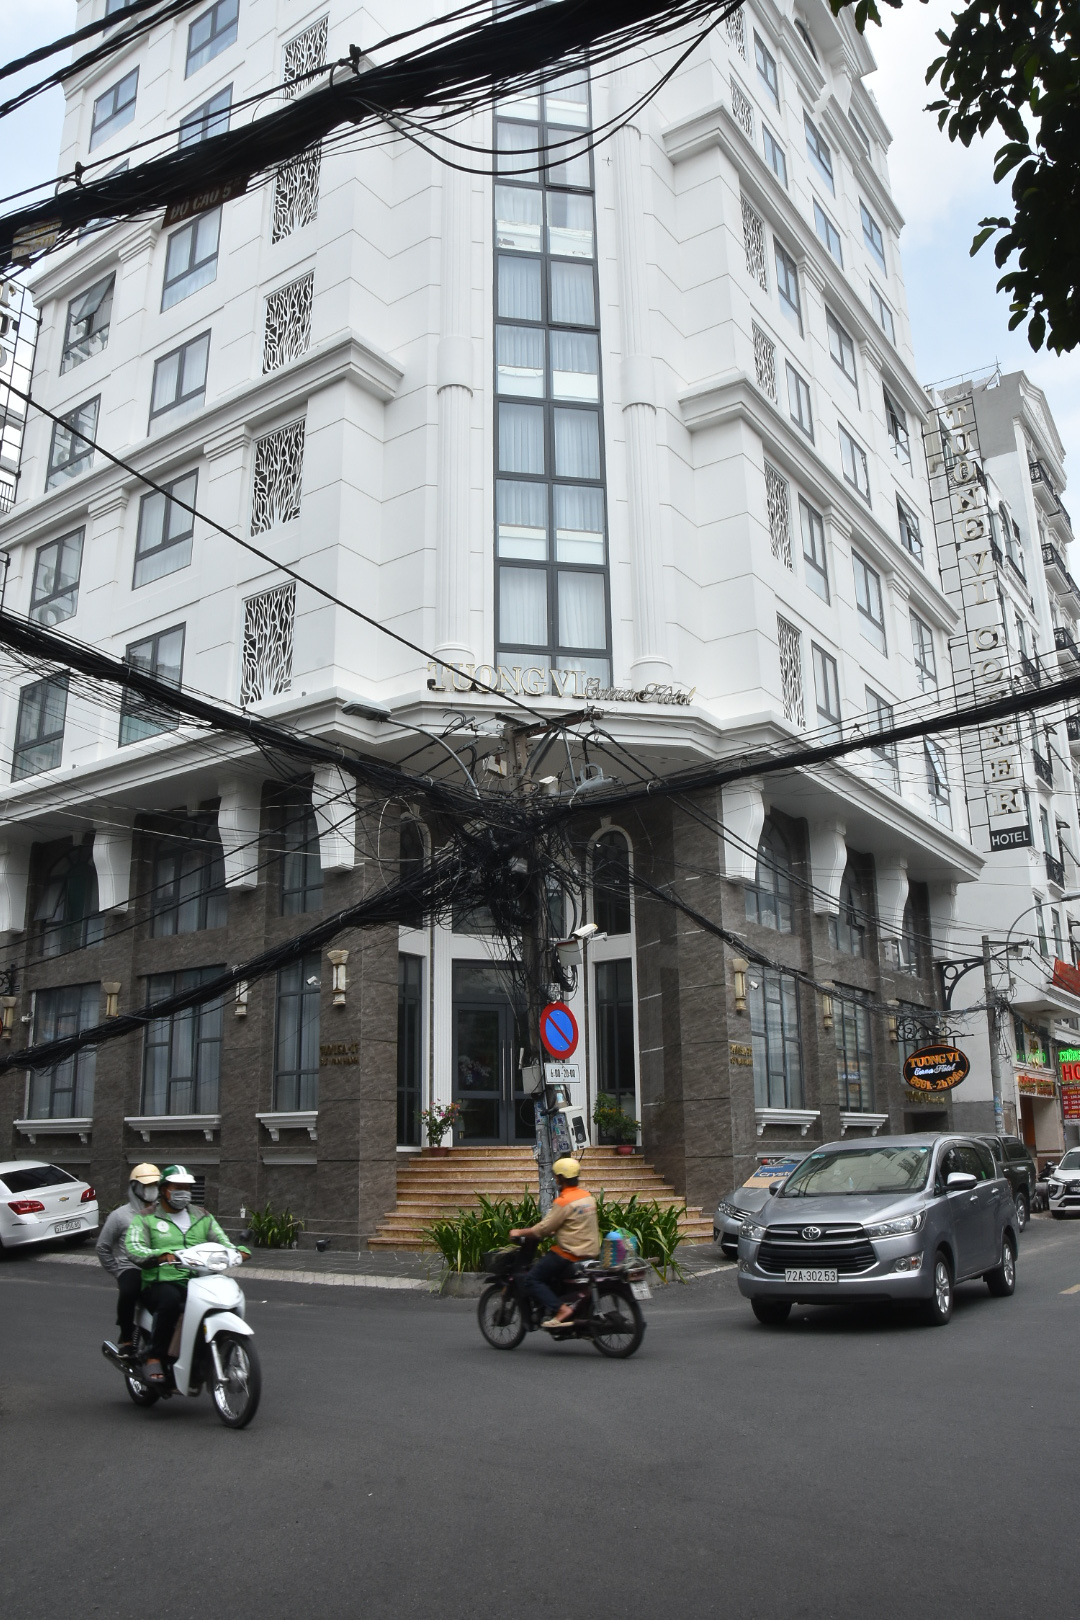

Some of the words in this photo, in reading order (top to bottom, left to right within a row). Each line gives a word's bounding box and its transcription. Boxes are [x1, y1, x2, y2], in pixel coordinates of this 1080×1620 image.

[945, 404, 985, 541] TUONG
[966, 551, 989, 604] VI
[427, 661, 547, 697] TUONG
[549, 669, 587, 699] VI
[974, 625, 1021, 816] CONER
[991, 829, 1029, 847] HOTEL
[909, 1054, 945, 1068] TUONG
[946, 1051, 960, 1062] VI
[786, 1270, 836, 1282] 72A-302.53
